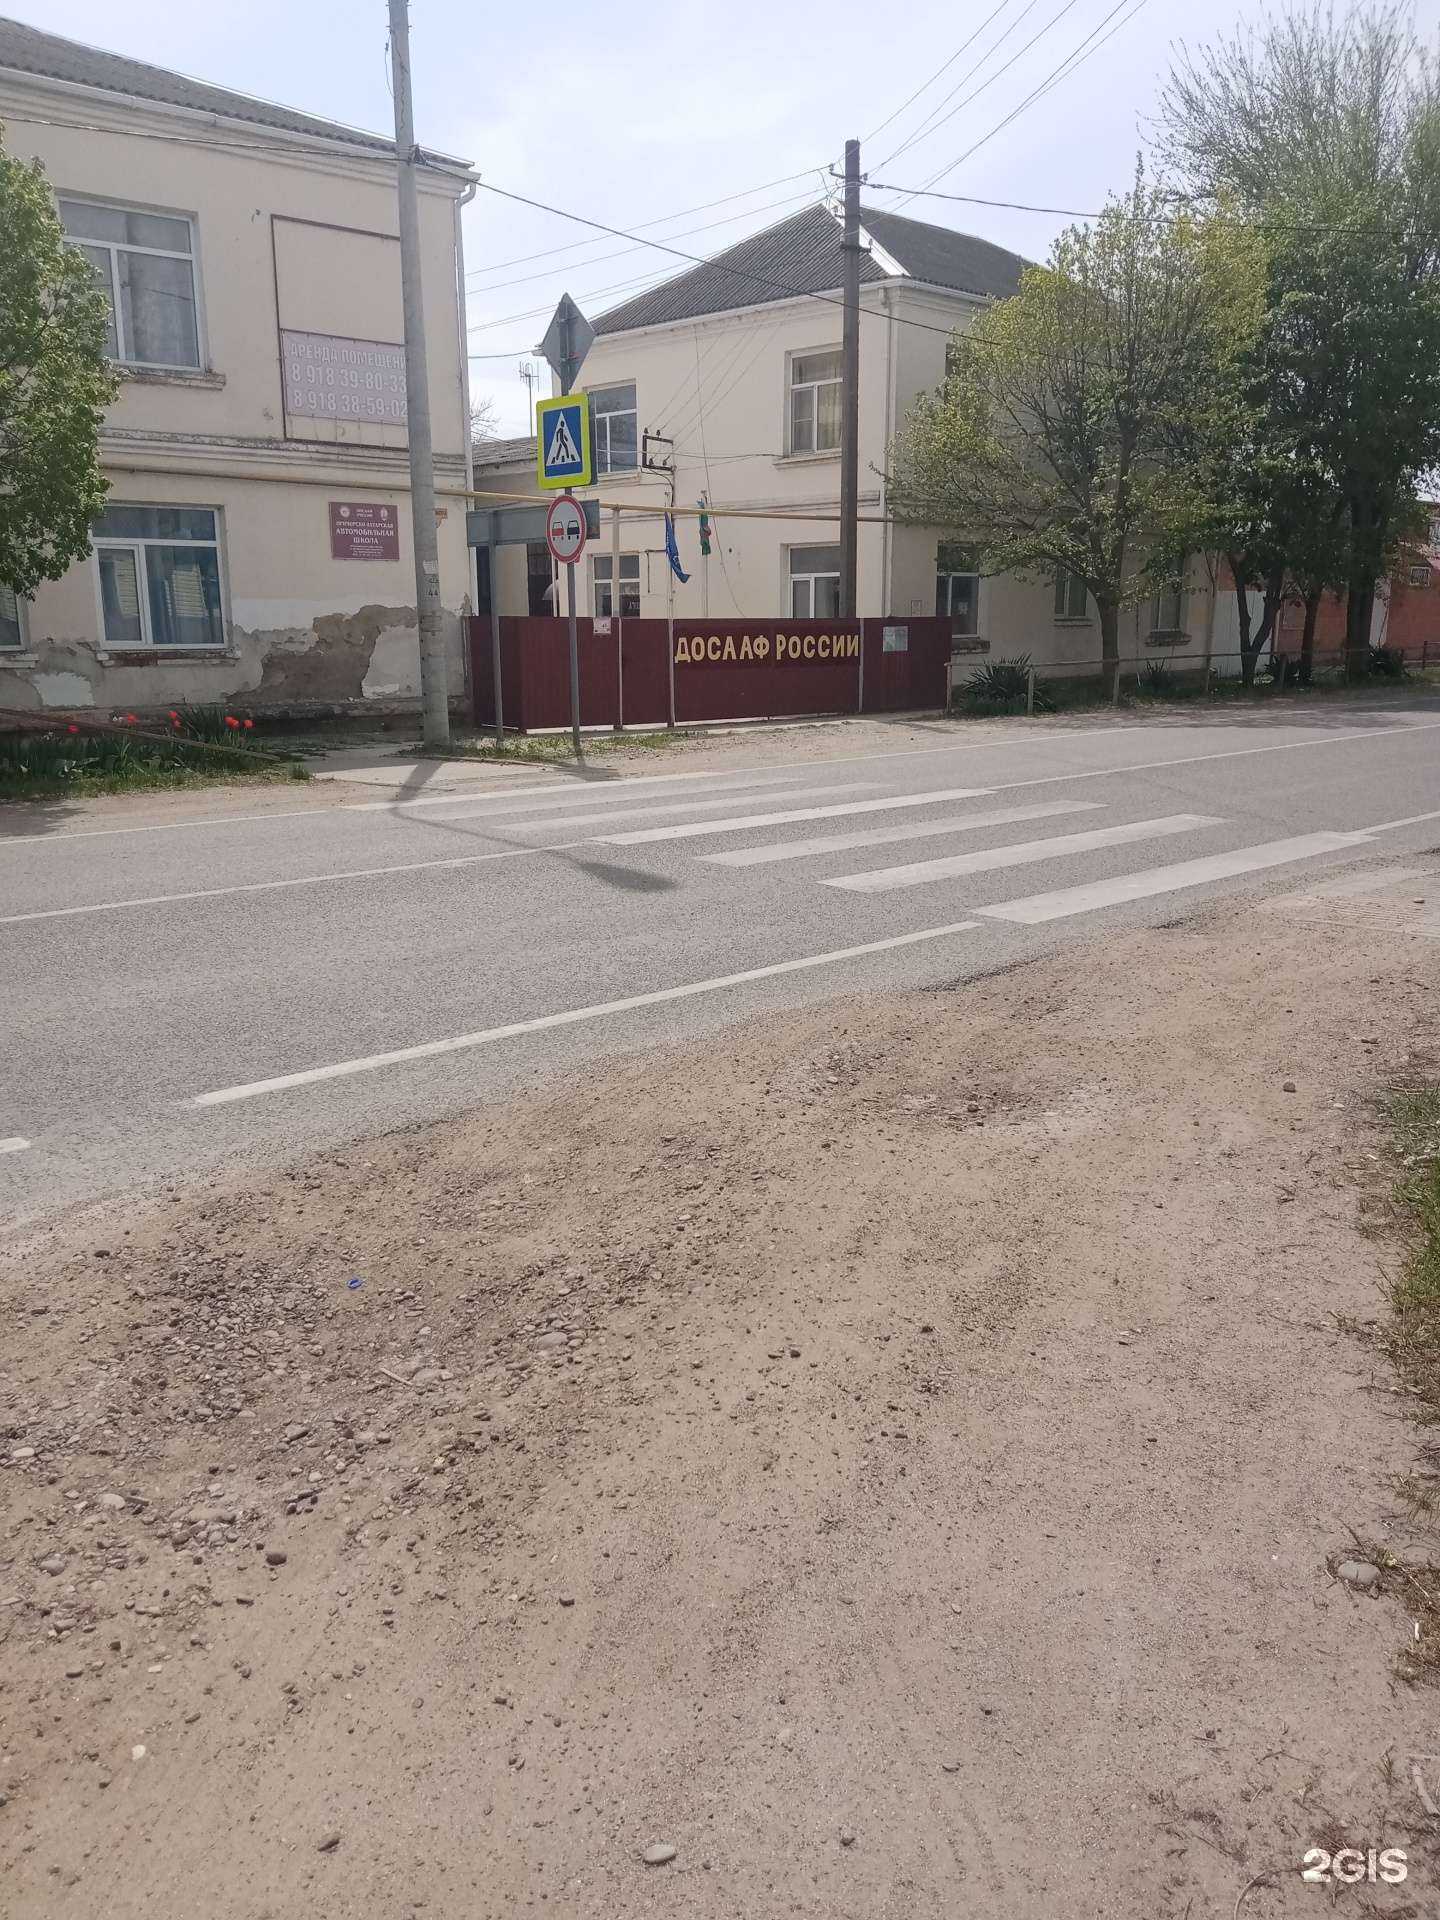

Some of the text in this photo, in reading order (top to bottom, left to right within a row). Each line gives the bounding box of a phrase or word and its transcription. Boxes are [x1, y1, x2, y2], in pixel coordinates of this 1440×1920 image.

[291, 343, 406, 369] АРЕНДА ПОМЕЩЕНИ
[292, 363, 301, 382] 8
[307, 365, 335, 385] 918
[294, 389, 408, 417] 8 918 38-59-02
[674, 635, 770, 663] ДОСААФ
[775, 634, 860, 660] РОССИИ
